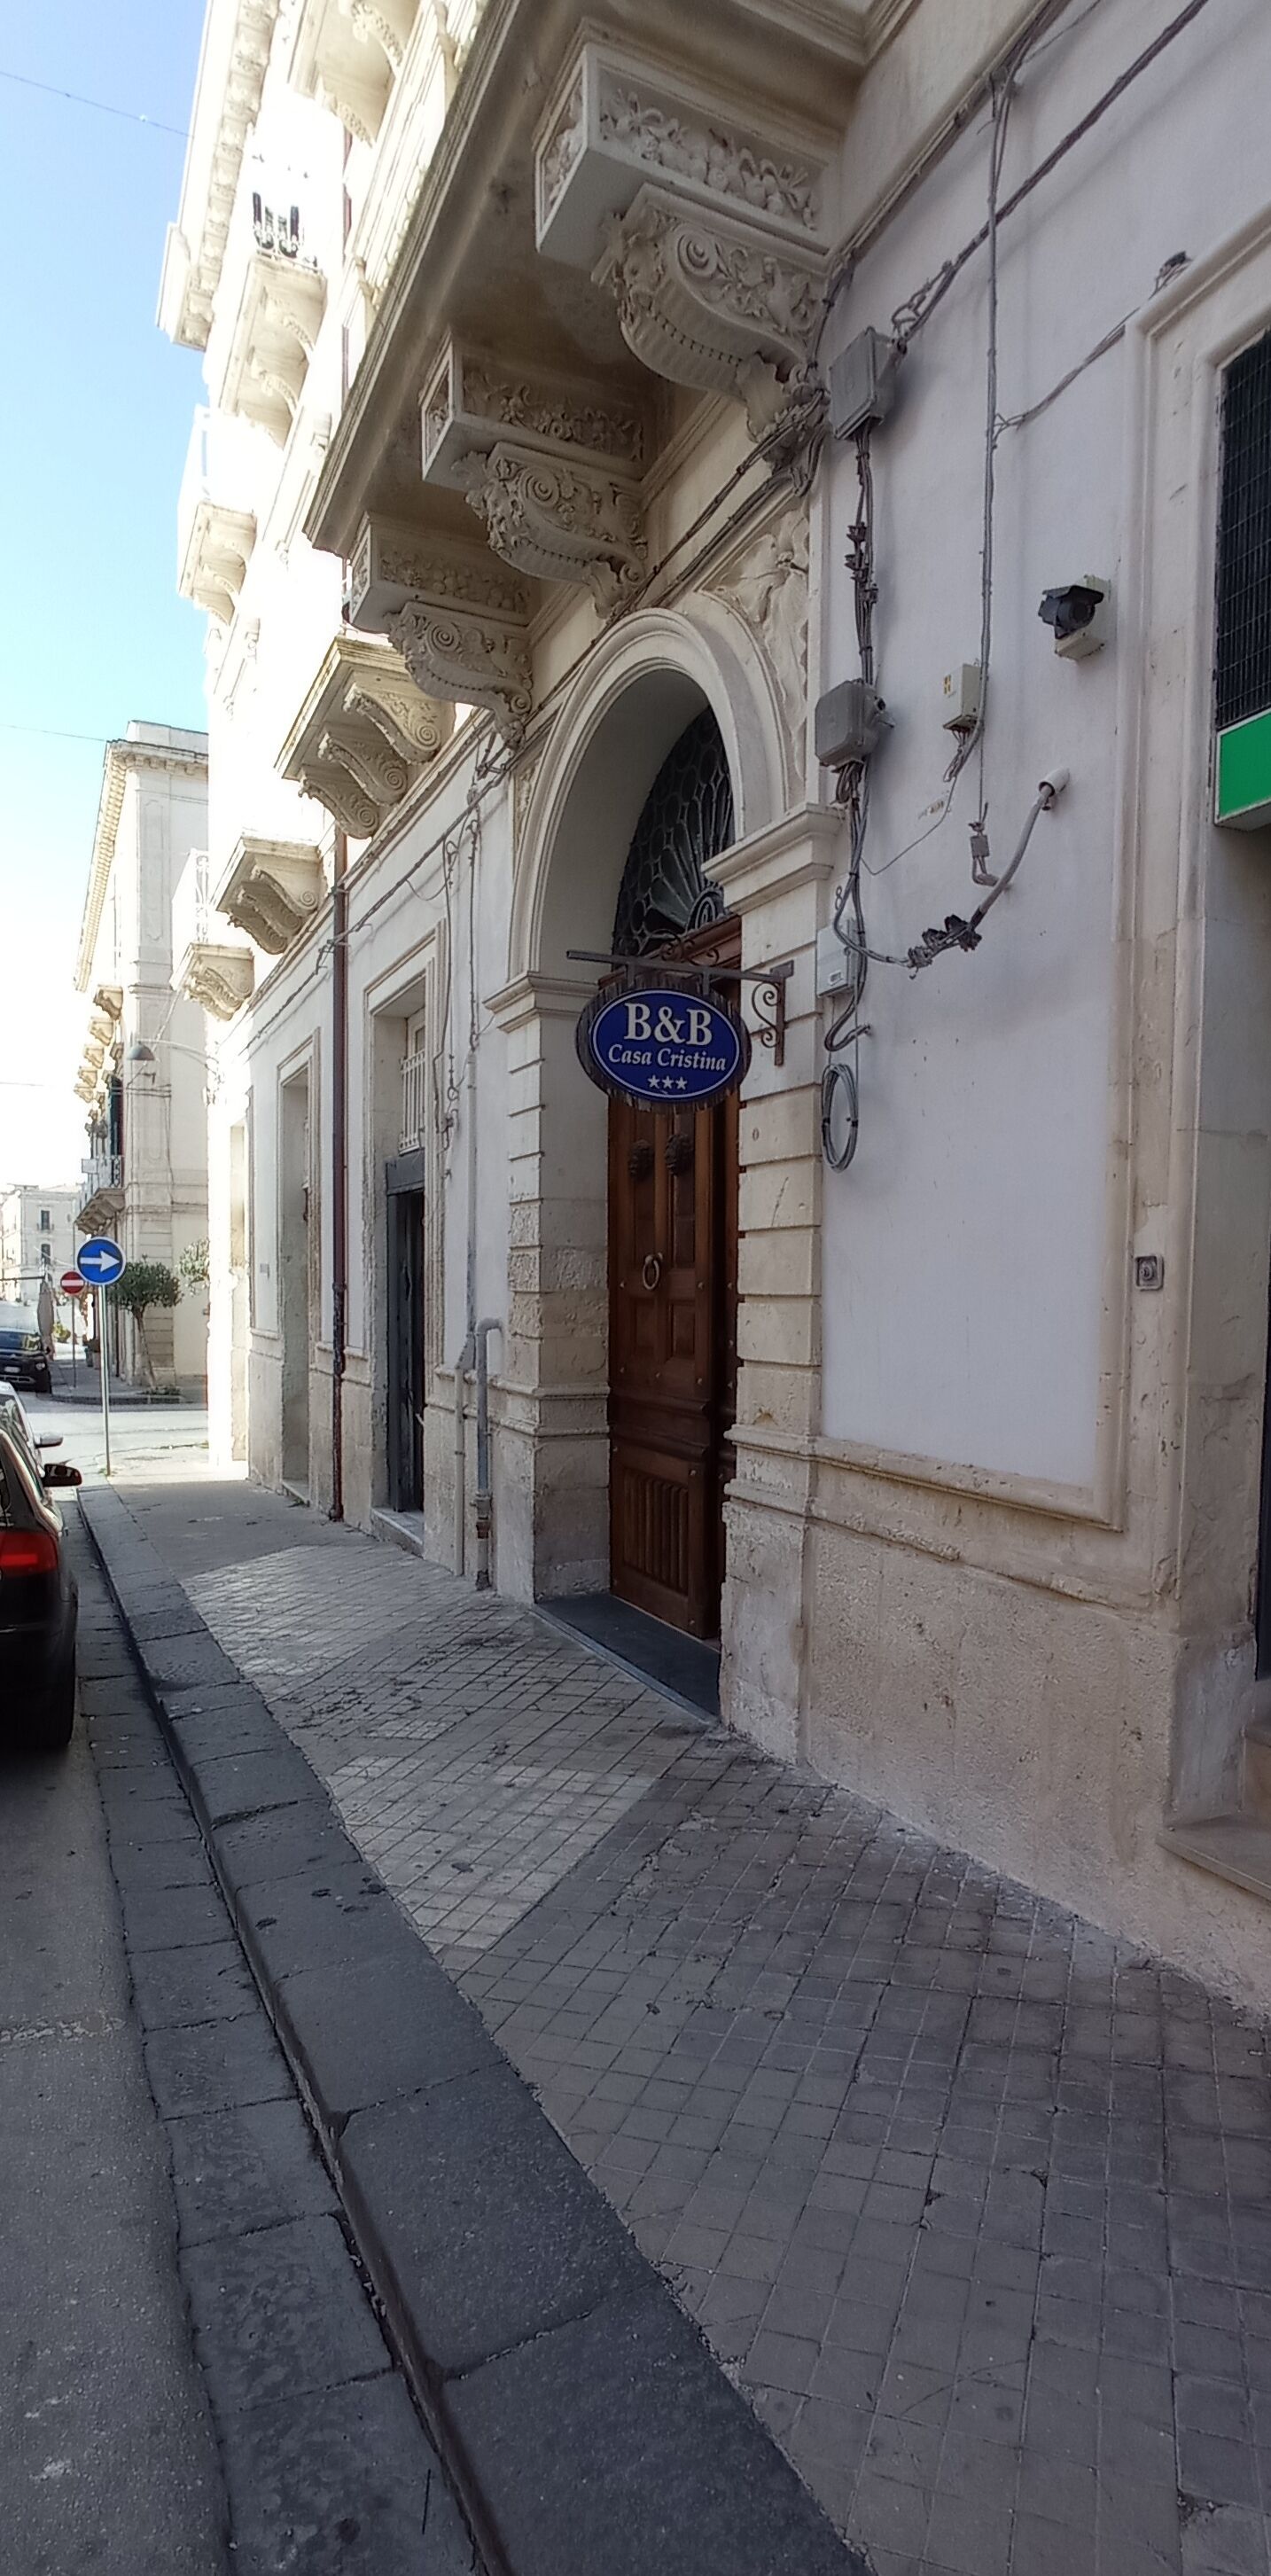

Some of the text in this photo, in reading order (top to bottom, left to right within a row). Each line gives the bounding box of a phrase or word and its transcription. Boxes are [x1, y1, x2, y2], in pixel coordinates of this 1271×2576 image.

[624, 1003, 713, 1046] B&B
[608, 1044, 726, 1071] Casa Cristina
